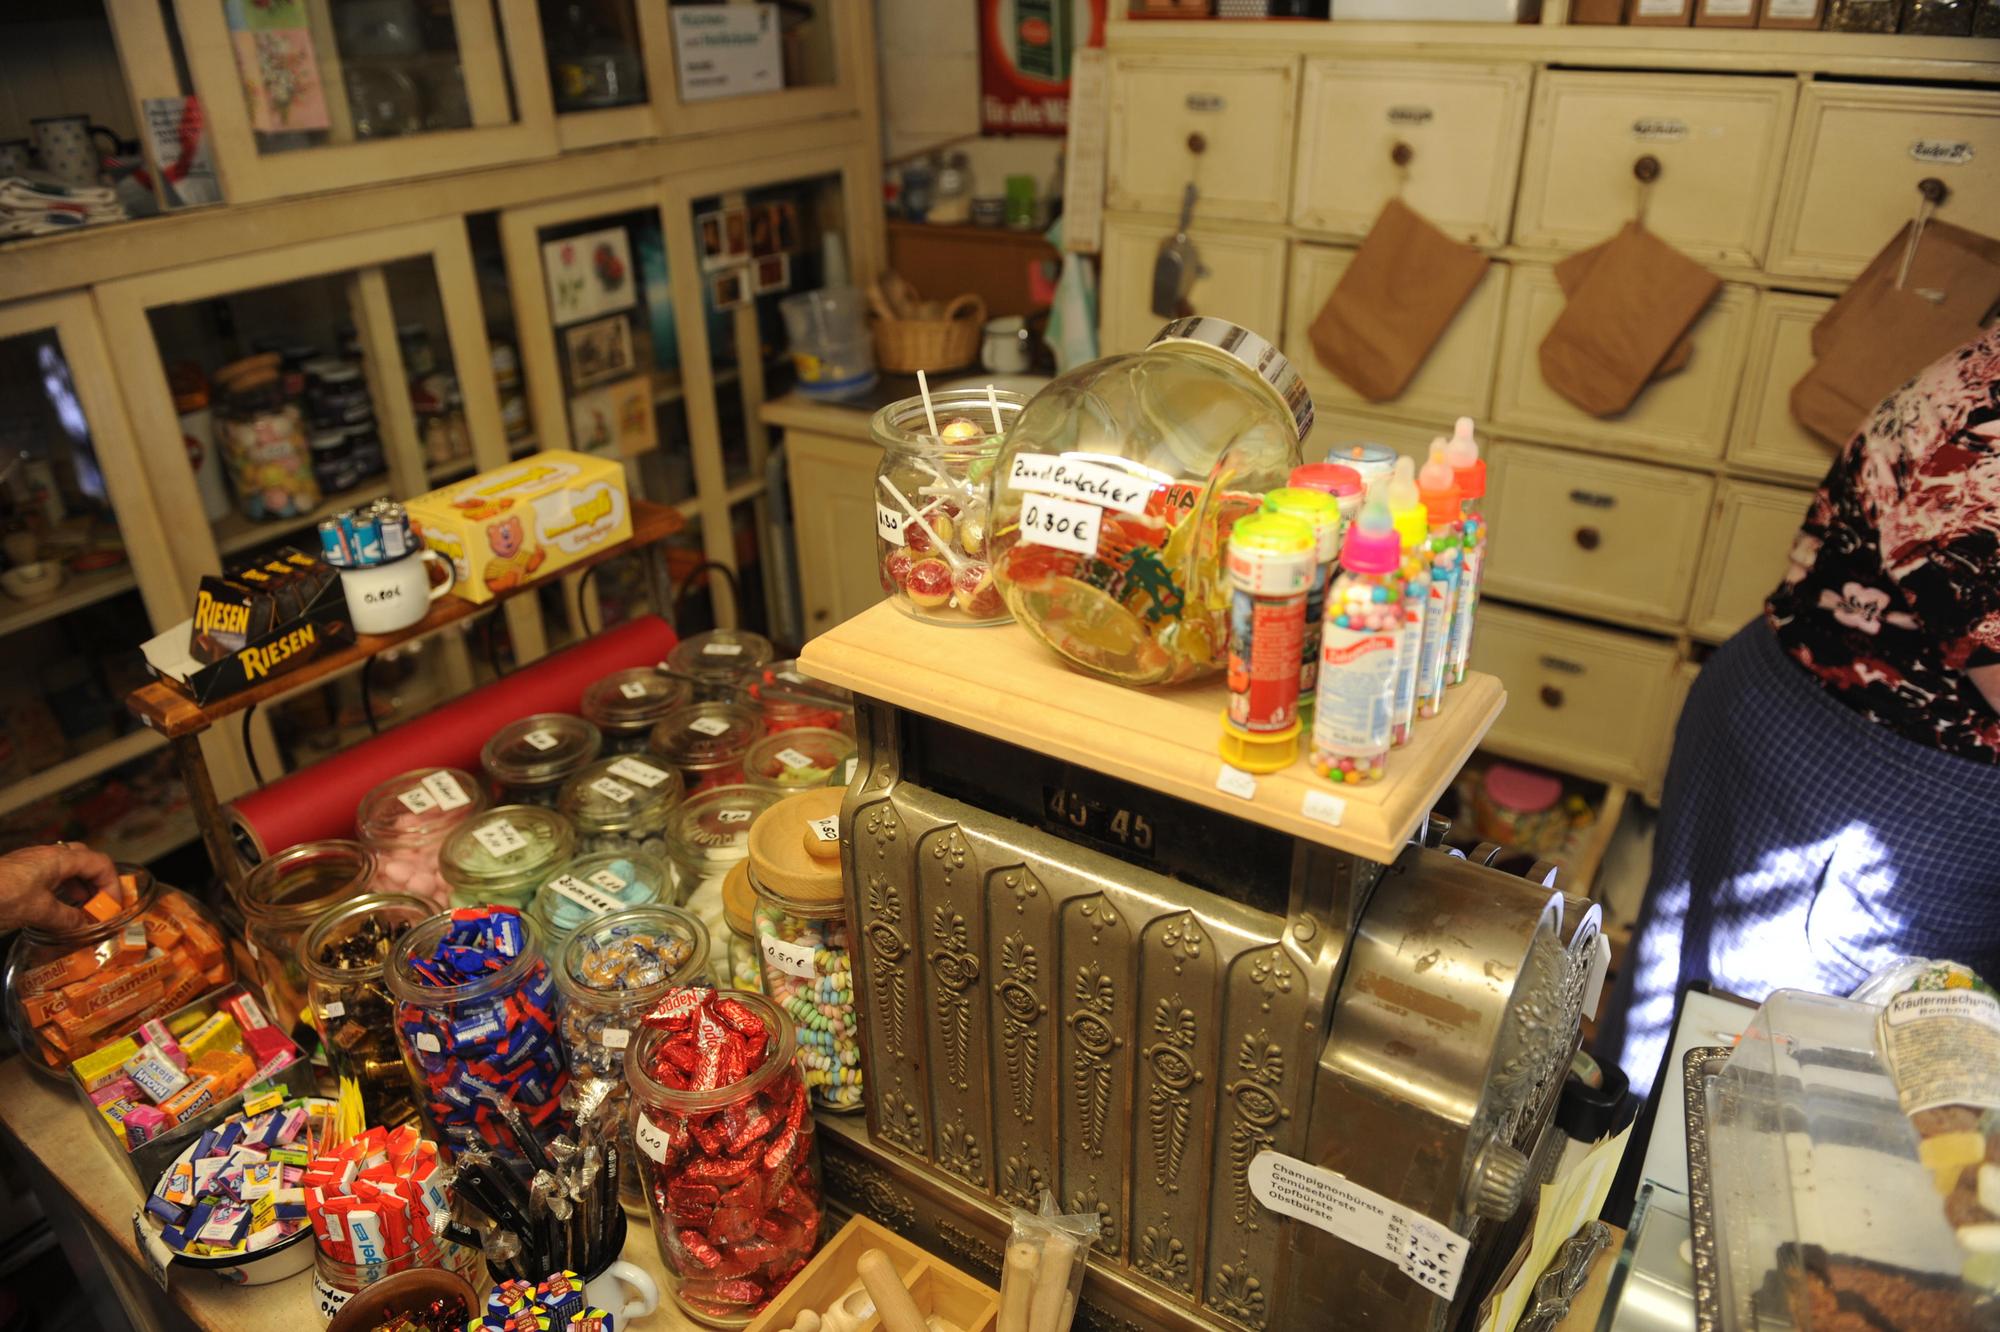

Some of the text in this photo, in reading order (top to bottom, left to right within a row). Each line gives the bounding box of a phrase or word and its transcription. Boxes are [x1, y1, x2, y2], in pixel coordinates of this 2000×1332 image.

[195, 591, 250, 635] RIESEN
[238, 623, 315, 681] RIESEN
[1110, 809, 1153, 849] 45
[88, 963, 159, 1012] Karamell
[657, 991, 699, 1016] Nappo
[134, 1068, 170, 1099] MAOAM
[149, 1061, 176, 1084] Bloxx
[178, 1090, 211, 1123] MAOAM
[1269, 1190, 1333, 1221] Obstbürste
[1270, 1181, 1334, 1212] Topfbürste
[1272, 1172, 1357, 1213] Gemüsebürste
[1273, 1163, 1385, 1216] Champignonbürste
